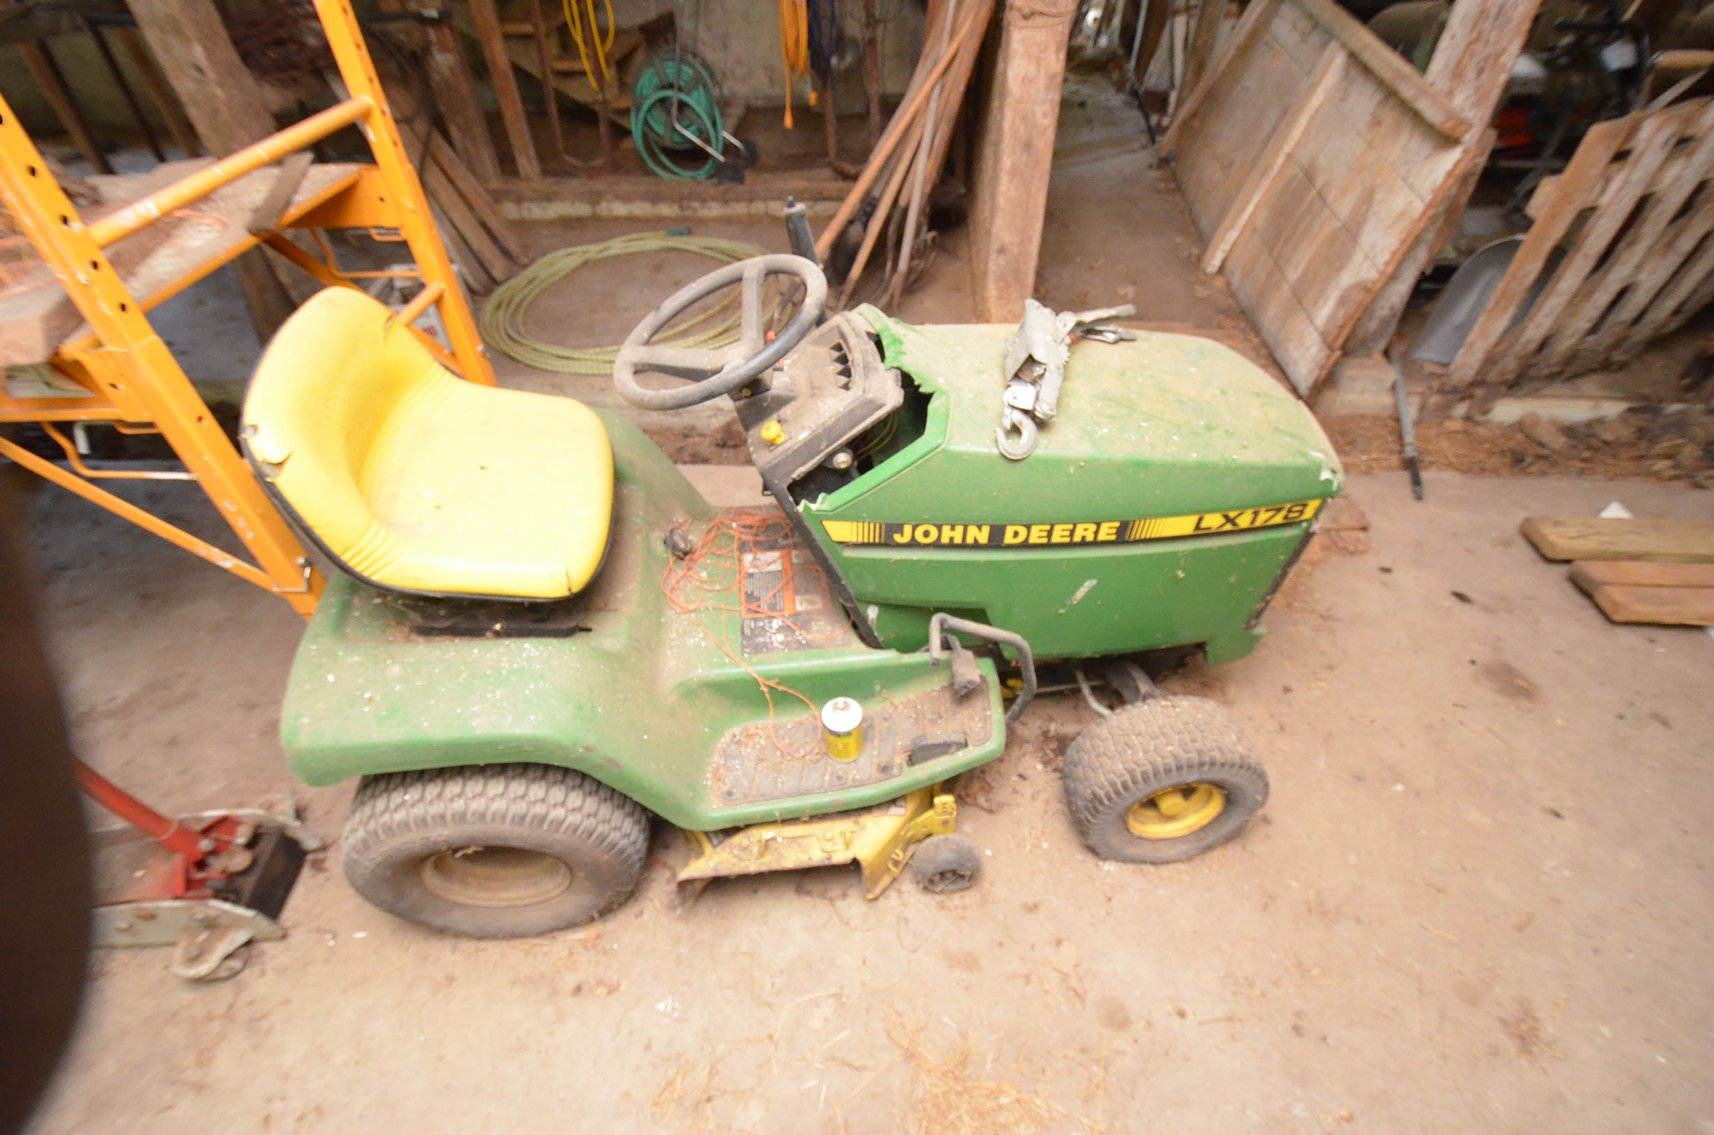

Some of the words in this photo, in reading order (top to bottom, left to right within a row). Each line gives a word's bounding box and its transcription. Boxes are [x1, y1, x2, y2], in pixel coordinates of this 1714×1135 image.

[1193, 502, 1309, 533] LX178
[893, 523, 991, 545] JOHN
[1003, 521, 1121, 545] DEERE
